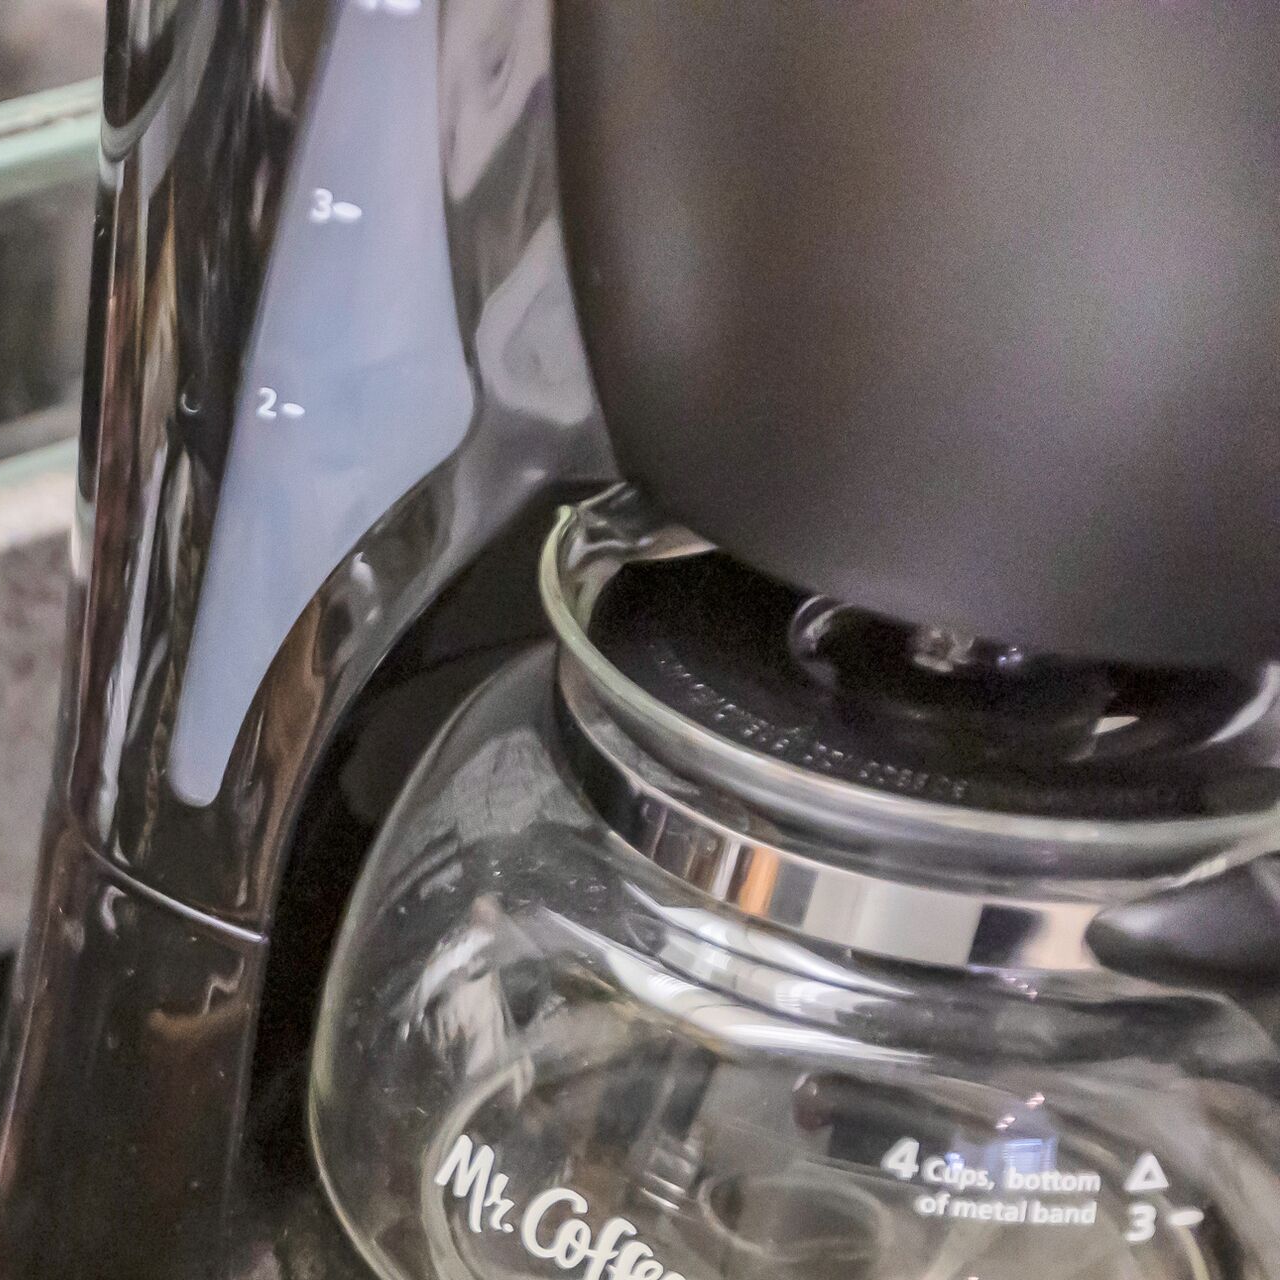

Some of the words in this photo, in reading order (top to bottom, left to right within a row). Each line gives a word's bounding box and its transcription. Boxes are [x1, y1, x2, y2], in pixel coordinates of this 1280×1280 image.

[309, 187, 334, 224] 3
[255, 387, 277, 419] 2
[880, 1136, 920, 1181] 4
[1005, 1167, 1102, 1193] bottom
[433, 1134, 516, 1234] Mr.
[915, 1194, 951, 1217] of
[952, 1199, 1028, 1224] metal
[1031, 1200, 1098, 1225] band
[1124, 1204, 1157, 1243] 3
